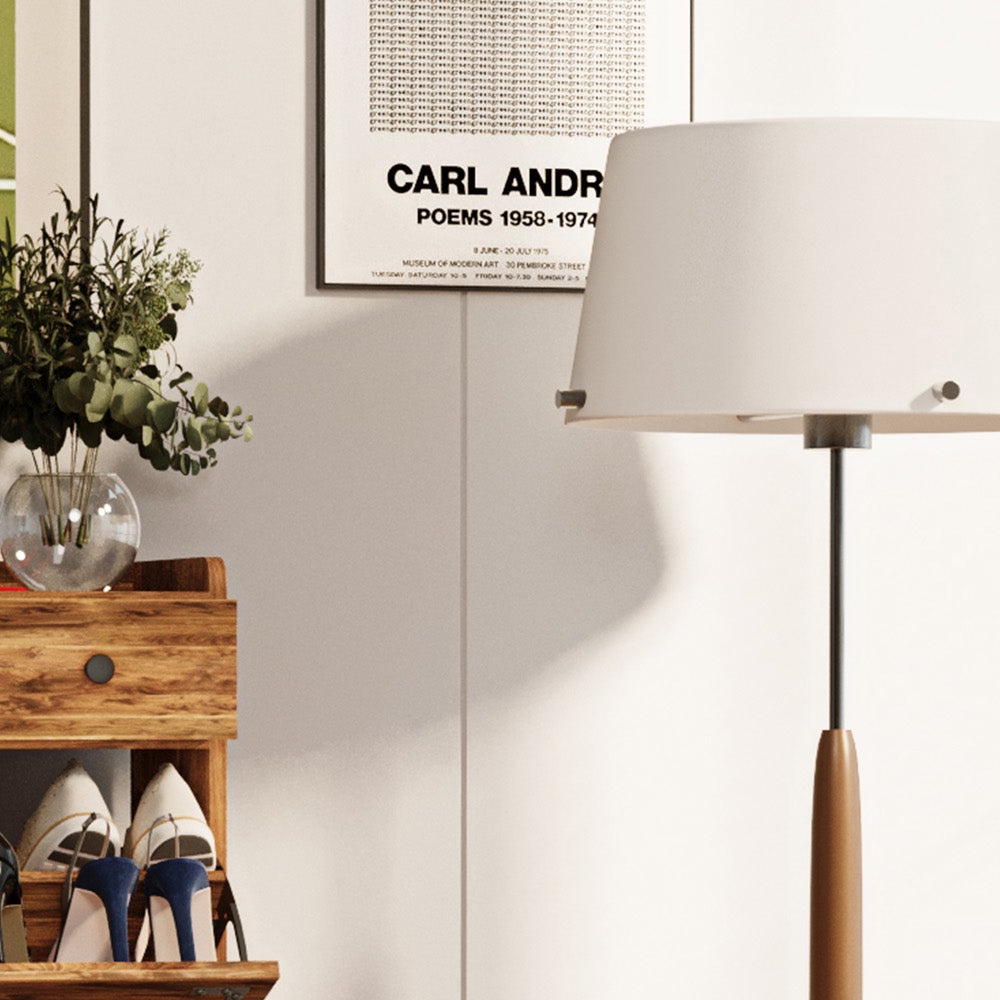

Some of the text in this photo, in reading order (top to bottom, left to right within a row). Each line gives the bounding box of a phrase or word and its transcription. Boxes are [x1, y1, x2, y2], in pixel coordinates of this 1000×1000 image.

[387, 163, 604, 198] CARL ANDR
[417, 208, 598, 228] POEMS 1958-1974
[504, 247, 515, 255] 20
[402, 260, 436, 268] MUSEUM
[437, 260, 448, 268] OF
[449, 260, 483, 268] MODERN
[516, 261, 557, 269] PEMBROKE
